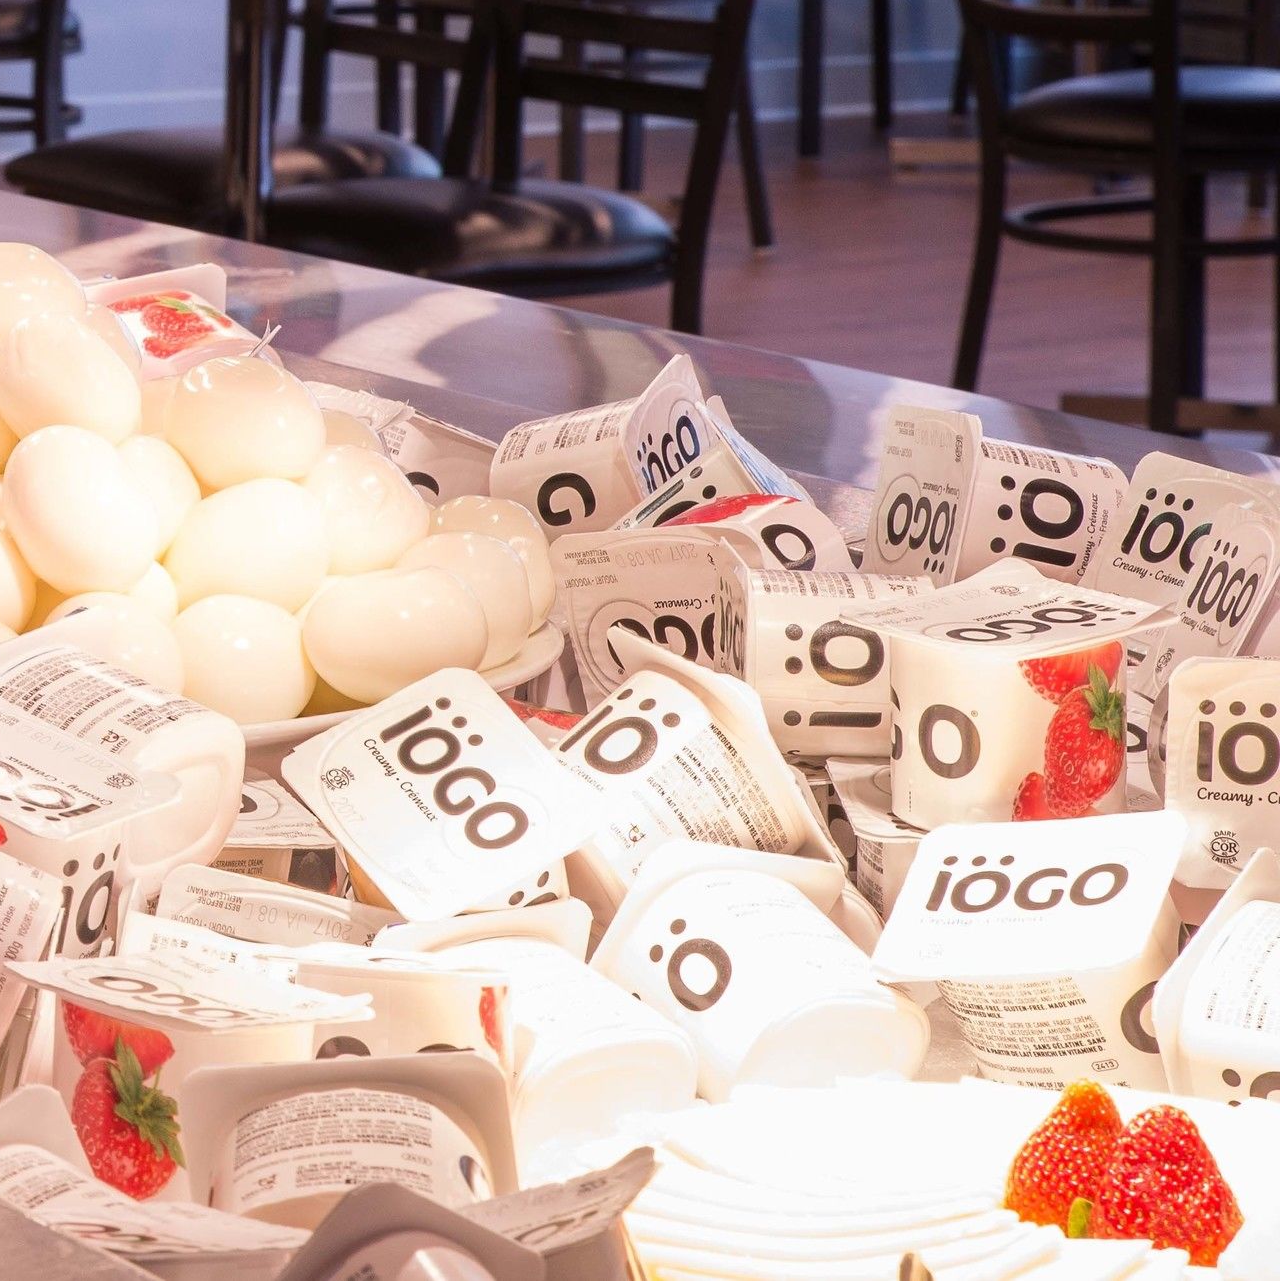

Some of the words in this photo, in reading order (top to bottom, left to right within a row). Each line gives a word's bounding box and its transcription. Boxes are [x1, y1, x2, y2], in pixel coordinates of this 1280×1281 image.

[1120, 487, 1213, 574] iÖG
[1077, 536, 1096, 577] Creamy
[1112, 557, 1148, 579] Creamy
[1154, 570, 1186, 588] Créme
[654, 598, 702, 610] Crémeux
[708, 722, 738, 757] INGREDIENTS:
[1196, 699, 1280, 785] iÖ
[363, 738, 398, 777] Creamy
[399, 781, 438, 823] Crémeux
[1197, 787, 1254, 806] Creamy
[1213, 830, 1236, 838] DAIRY
[1211, 841, 1237, 853] COR
[186, 885, 215, 897] AVANT
[197, 898, 224, 909] BEFORE
[224, 902, 241, 912] BEST
[0, 905, 16, 932] Fraise
[1048, 1001, 1067, 1009] MADE
[1068, 998, 1087, 1006] WITH
[1087, 1036, 1107, 1045] SANS
[1067, 1046, 1095, 1055] VITAMINE
